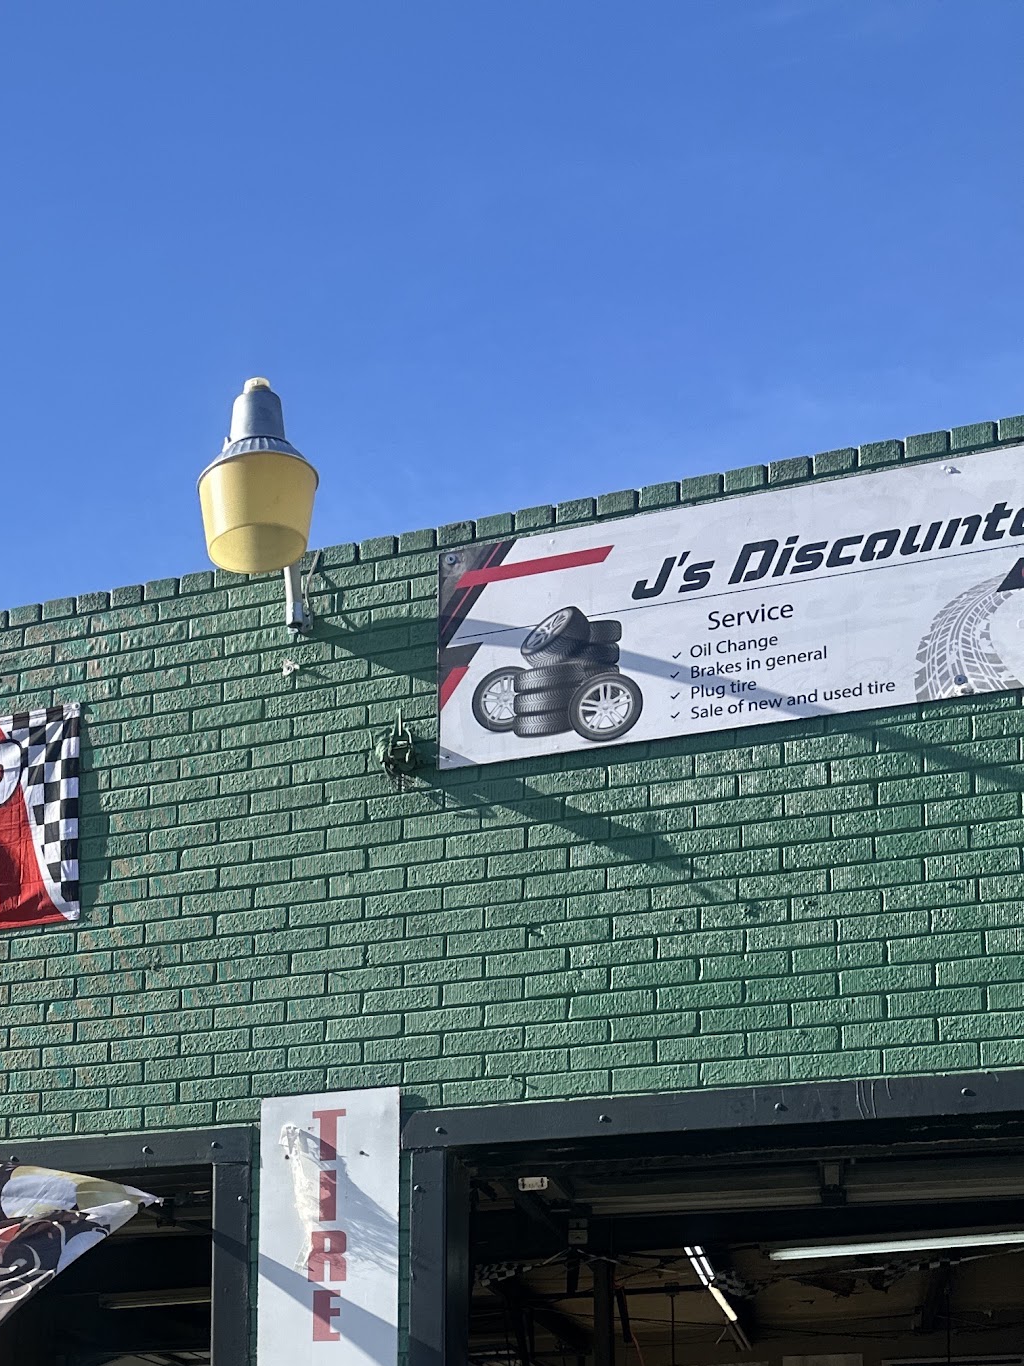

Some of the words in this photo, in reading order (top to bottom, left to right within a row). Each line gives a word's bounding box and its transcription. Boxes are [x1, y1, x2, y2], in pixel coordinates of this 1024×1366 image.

[632, 551, 716, 601] J's
[708, 604, 795, 631] Service
[689, 642, 712, 658] Oil
[715, 634, 779, 655] Change
[690, 660, 743, 679] Brakes
[746, 657, 761, 671] in
[765, 645, 828, 671] general
[690, 683, 726, 700] Plug
[729, 678, 758, 694] tire
[690, 702, 724, 720] Sale
[727, 698, 745, 715] of
[748, 698, 783, 712] new
[786, 688, 818, 707] and
[823, 682, 864, 702] used
[867, 679, 897, 696] tire
[307, 1106, 347, 1343] TIRE
